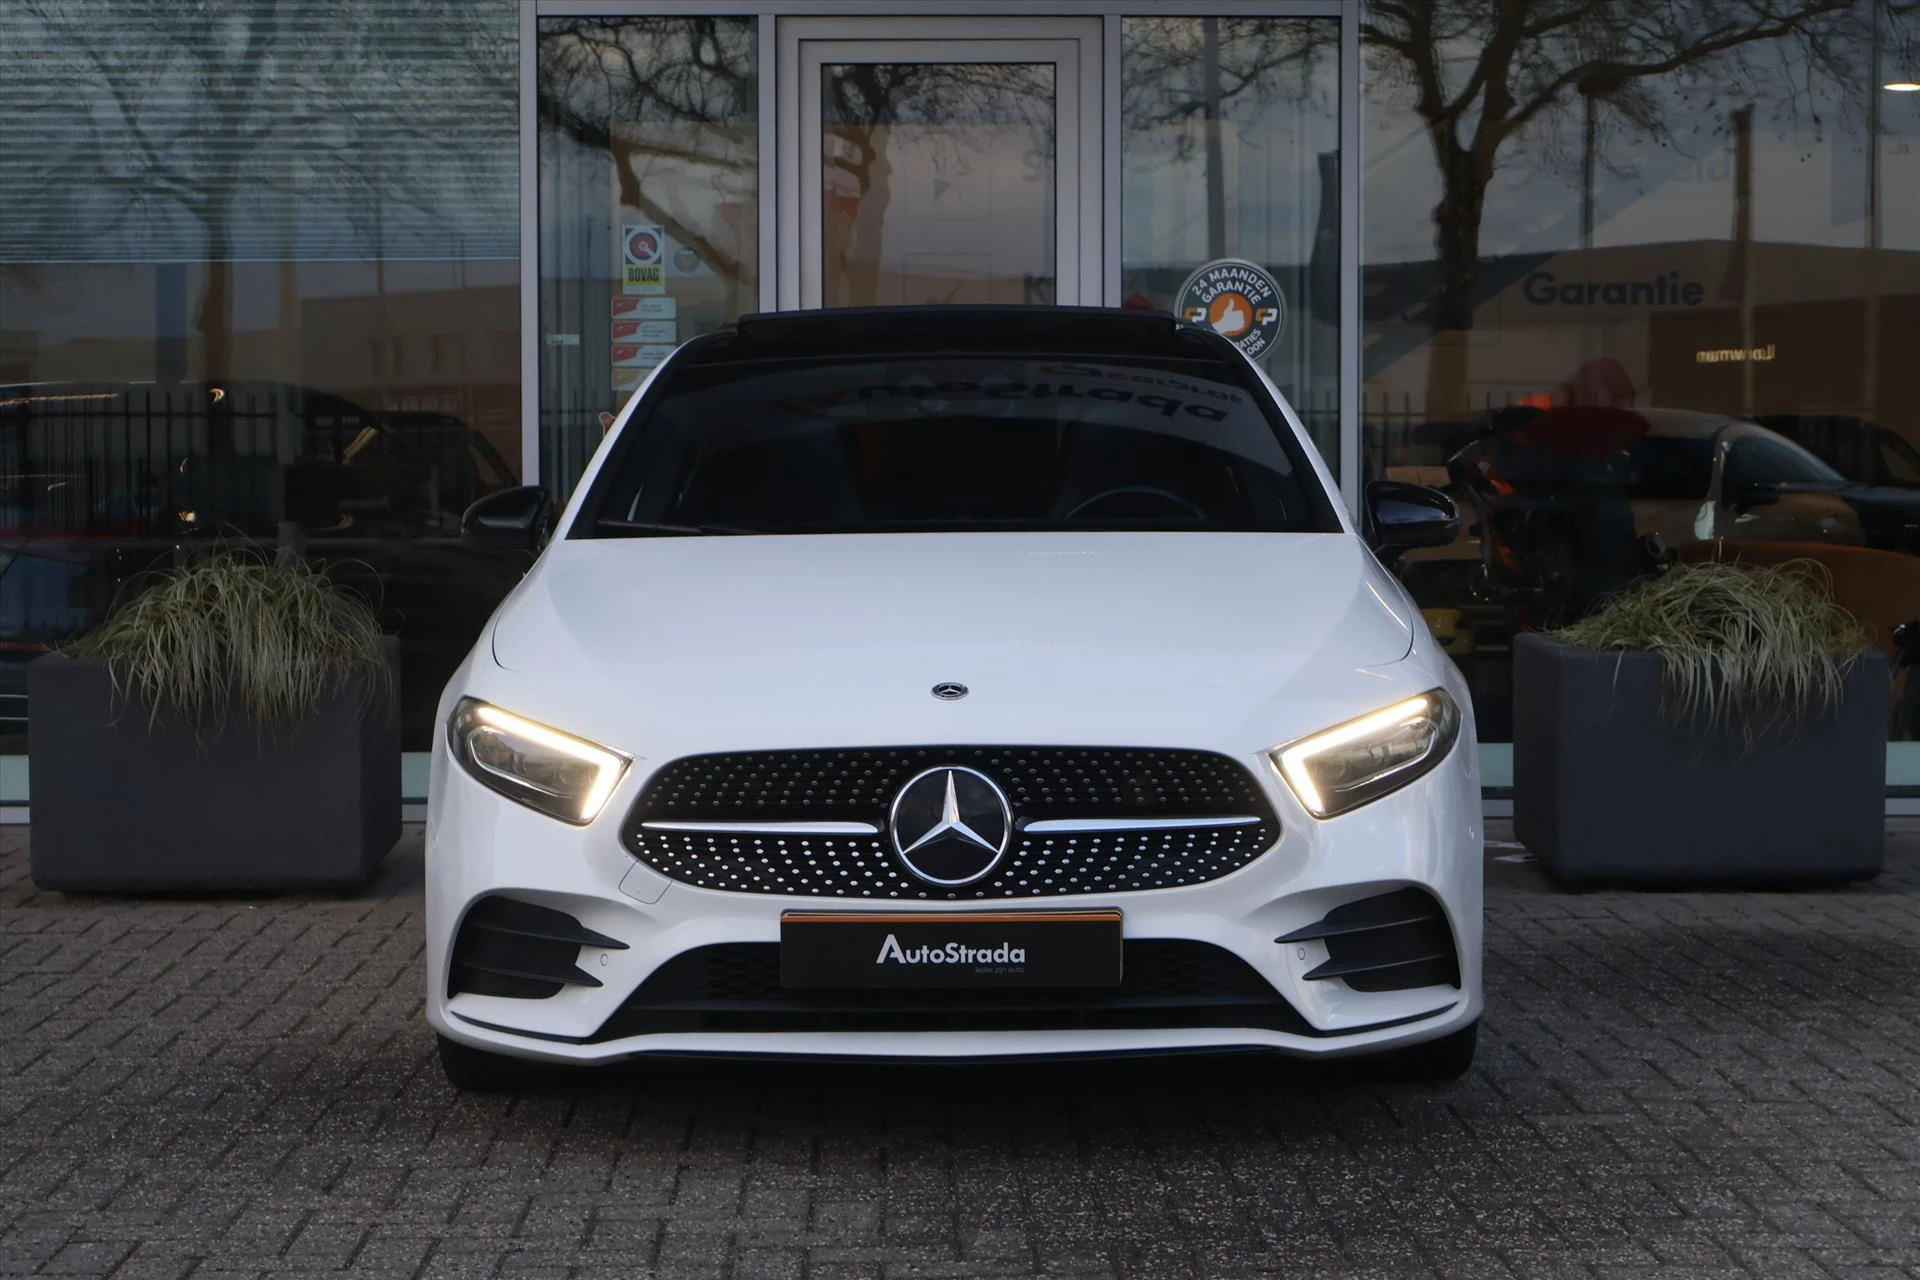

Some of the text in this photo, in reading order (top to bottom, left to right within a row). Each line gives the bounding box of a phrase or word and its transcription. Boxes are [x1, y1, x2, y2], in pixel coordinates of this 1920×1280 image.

[628, 267, 659, 282] BOVAG
[1191, 268, 1272, 298] 24 MAANDEN
[1522, 270, 1705, 306] Garantie
[1201, 281, 1262, 305] GARANTIE
[876, 934, 1026, 964] AutoStrada
